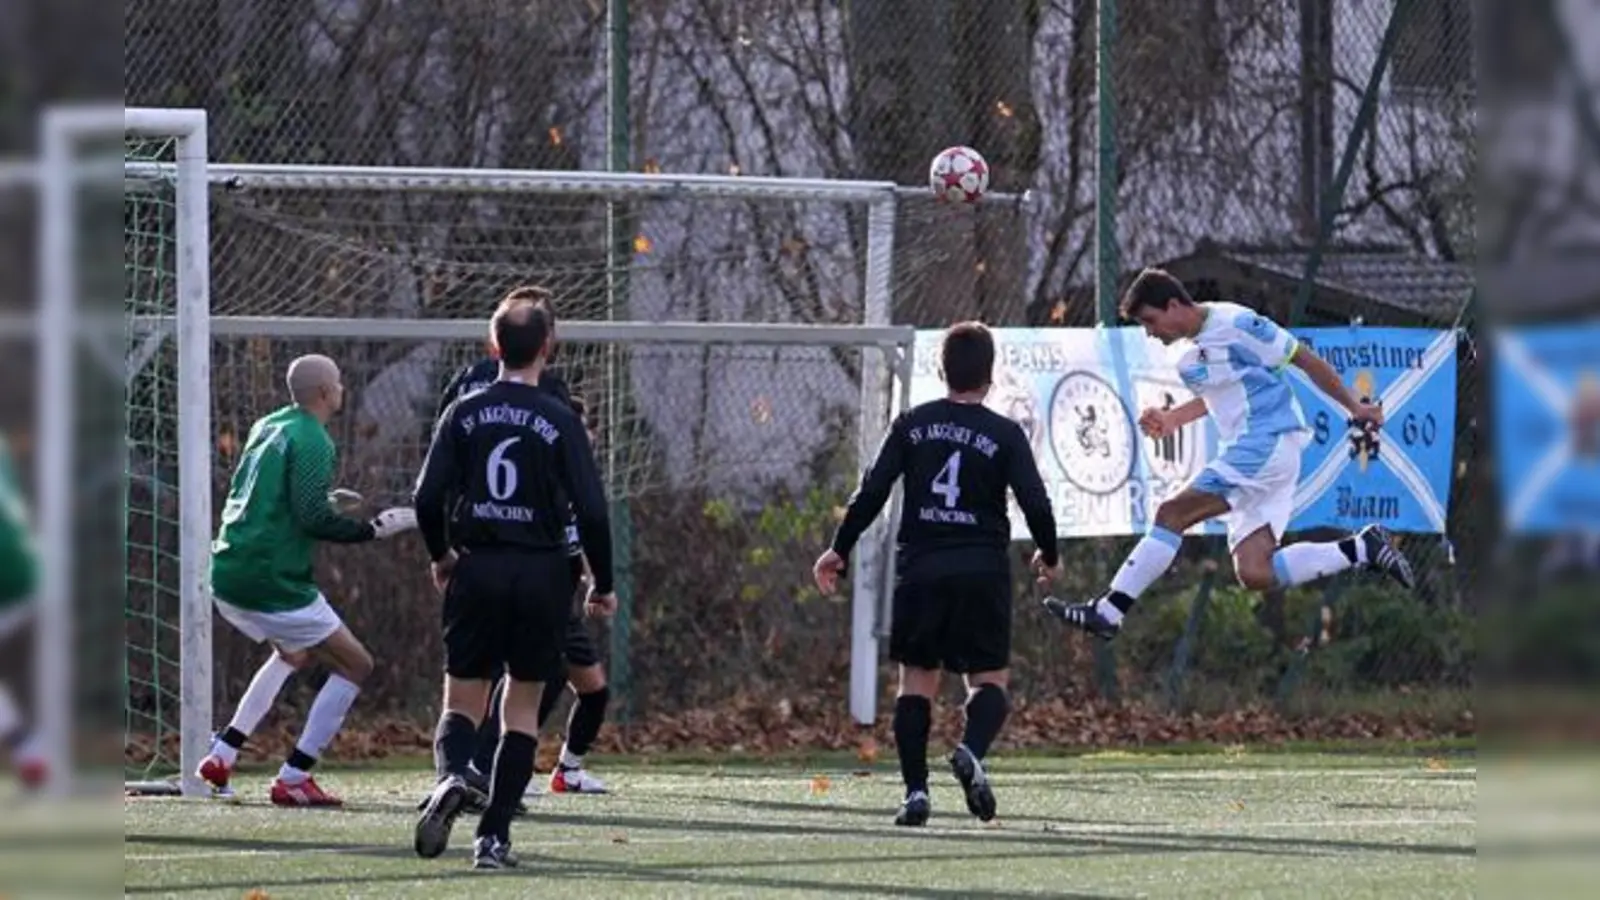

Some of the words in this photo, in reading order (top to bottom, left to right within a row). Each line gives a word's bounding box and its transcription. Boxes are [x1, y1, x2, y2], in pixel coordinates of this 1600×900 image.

[487, 436, 521, 500] 6
[932, 450, 961, 507] 4
[472, 500, 533, 522] MÜNCHEN
[919, 507, 977, 524] MÜNCHEN
